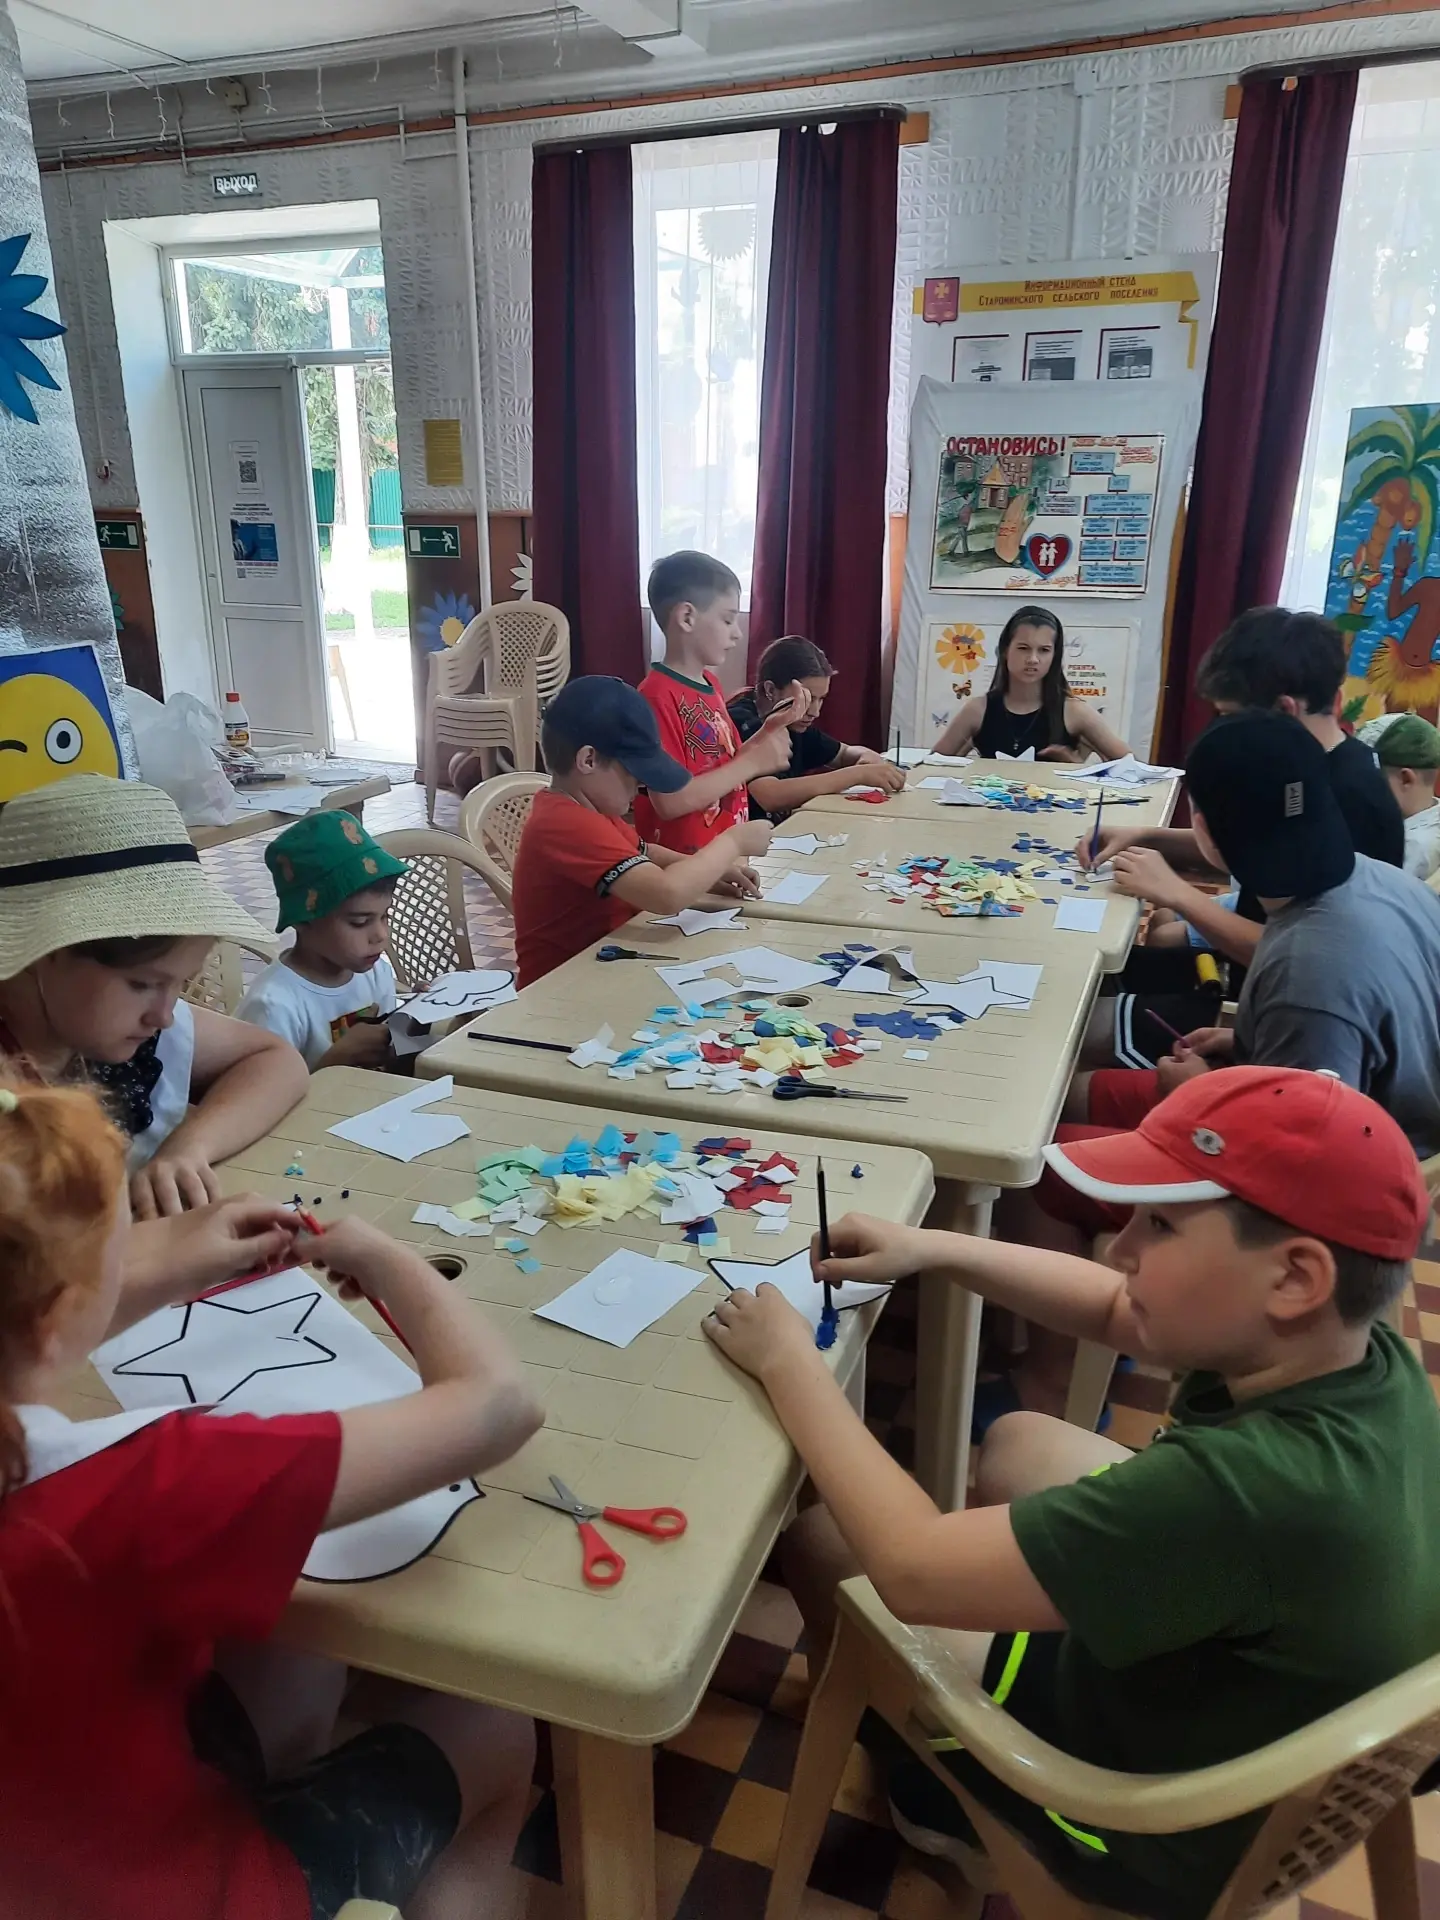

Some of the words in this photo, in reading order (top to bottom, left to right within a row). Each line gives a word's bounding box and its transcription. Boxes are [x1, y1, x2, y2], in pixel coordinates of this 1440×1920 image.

[215, 175, 258, 191] ВЫХОД
[1052, 291, 1100, 303] СЕЛЬСКОГО
[1110, 287, 1158, 299] ПОСЕЛЕНИЯ
[946, 436, 1065, 456] ОСТАНОВИСЬ!
